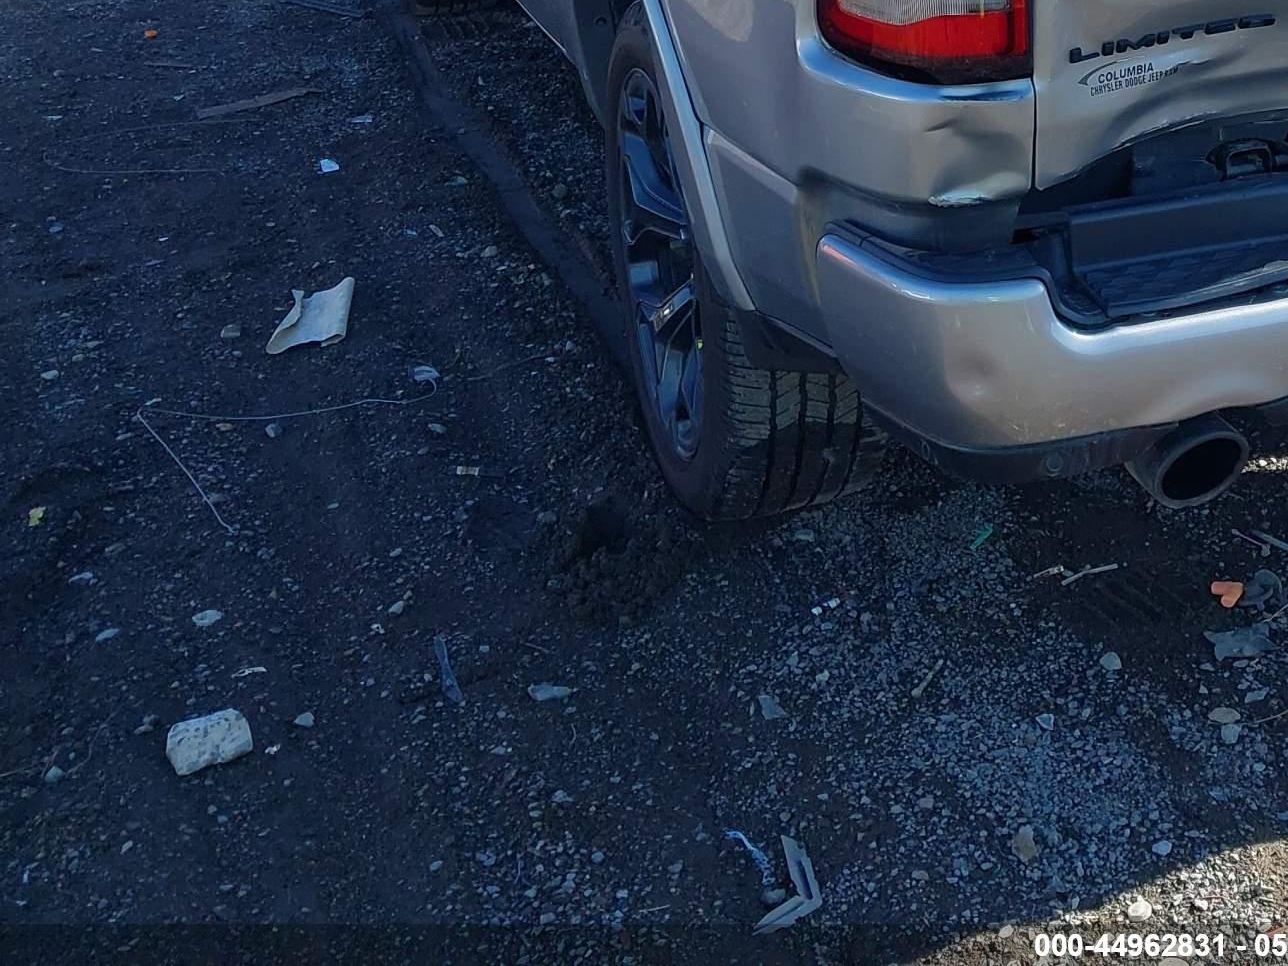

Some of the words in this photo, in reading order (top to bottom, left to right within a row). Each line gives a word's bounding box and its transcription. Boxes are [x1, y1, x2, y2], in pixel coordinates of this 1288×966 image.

[1069, 14, 1276, 63] LIMITED
[1090, 81, 1123, 97] CHRYSLER
[1125, 75, 1146, 88] DODGE
[1148, 70, 1164, 83] JEEP
[1098, 62, 1154, 84] COLUMBIA
